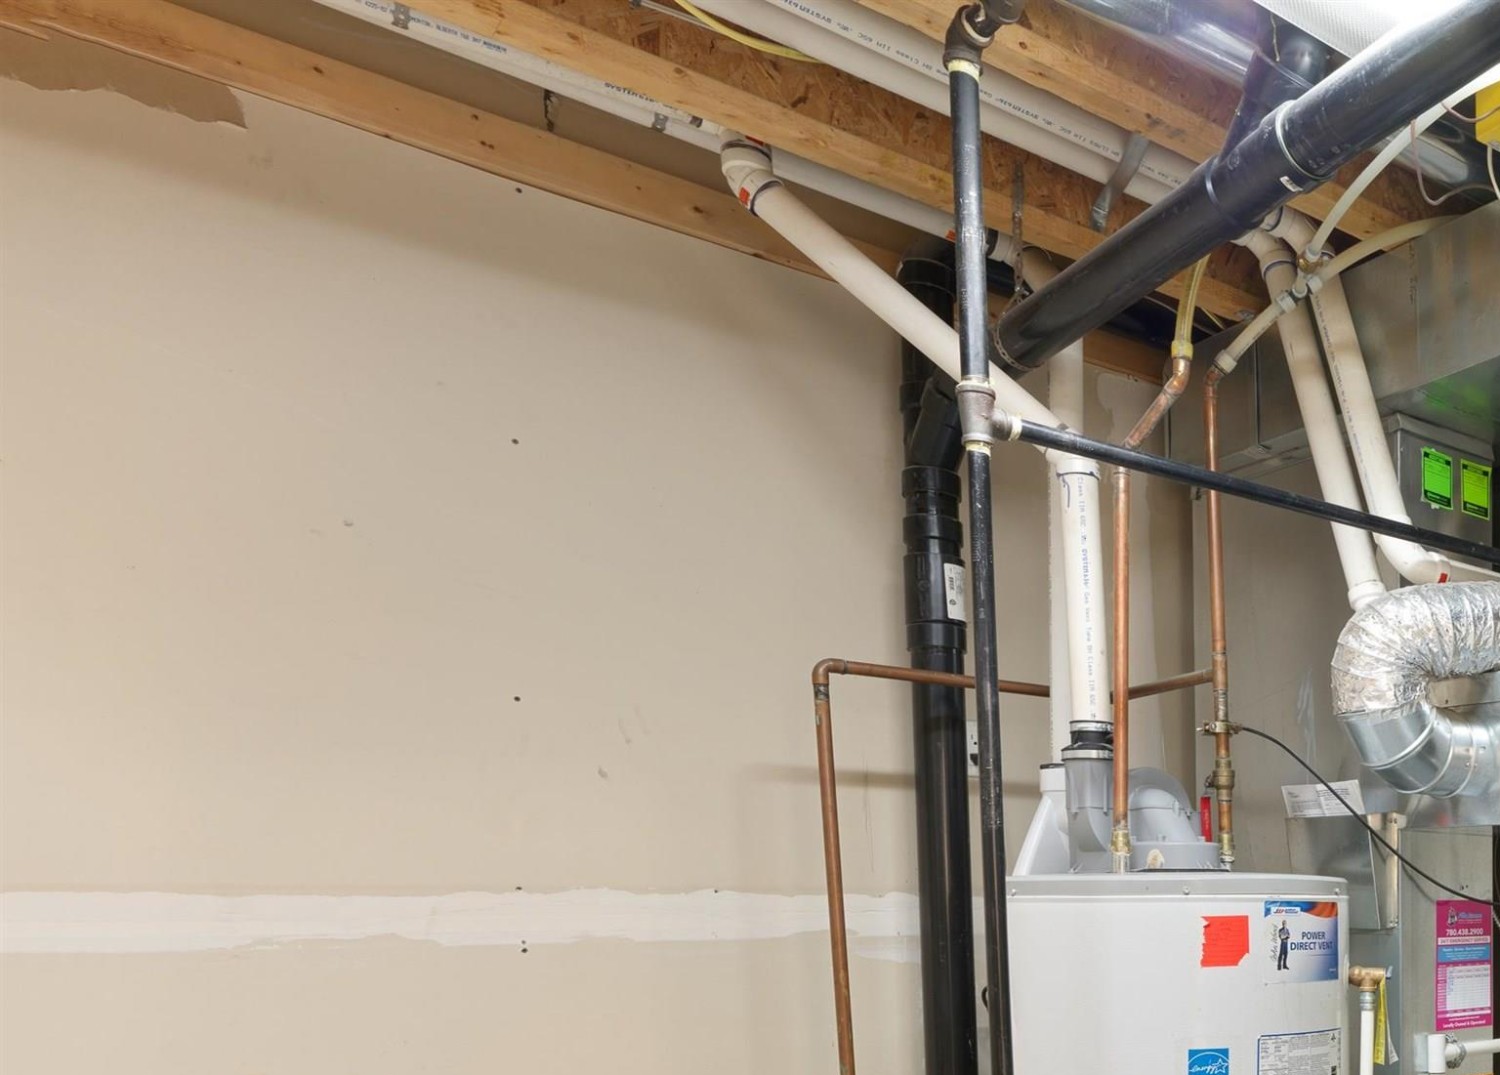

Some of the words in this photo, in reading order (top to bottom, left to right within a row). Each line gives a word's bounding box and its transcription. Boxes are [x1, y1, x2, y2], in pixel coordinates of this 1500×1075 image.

[1302, 931, 1325, 940] POWER
[1290, 942, 1316, 950] DIRECT
[1318, 941, 1333, 950] VENT
